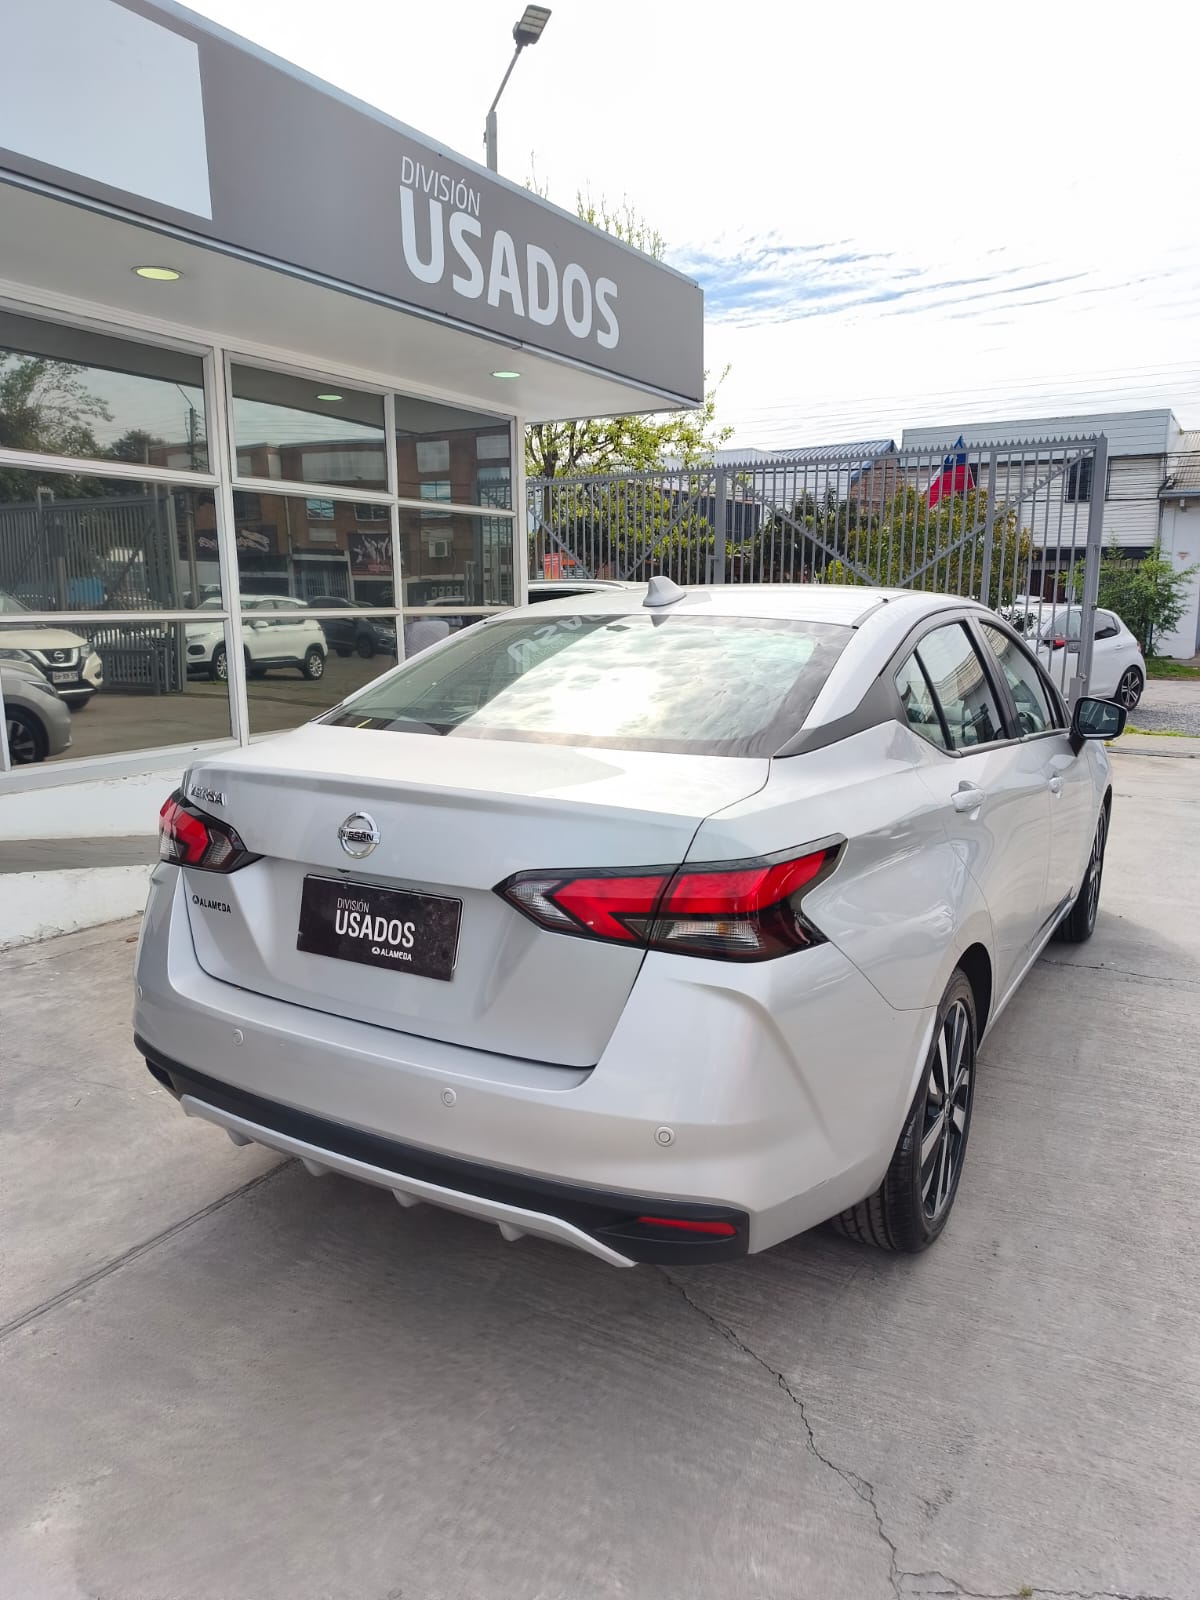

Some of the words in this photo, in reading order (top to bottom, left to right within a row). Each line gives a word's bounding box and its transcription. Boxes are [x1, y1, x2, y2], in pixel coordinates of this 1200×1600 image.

[401, 155, 481, 217] DIVISIÓN
[399, 184, 620, 349] USADOS
[340, 829, 375, 842] NISSAN
[199, 898, 232, 914] ALAMEDA
[337, 897, 370, 913] DIVISIÓN
[335, 909, 416, 948] USADOS
[380, 948, 413, 962] ALAMEDA
